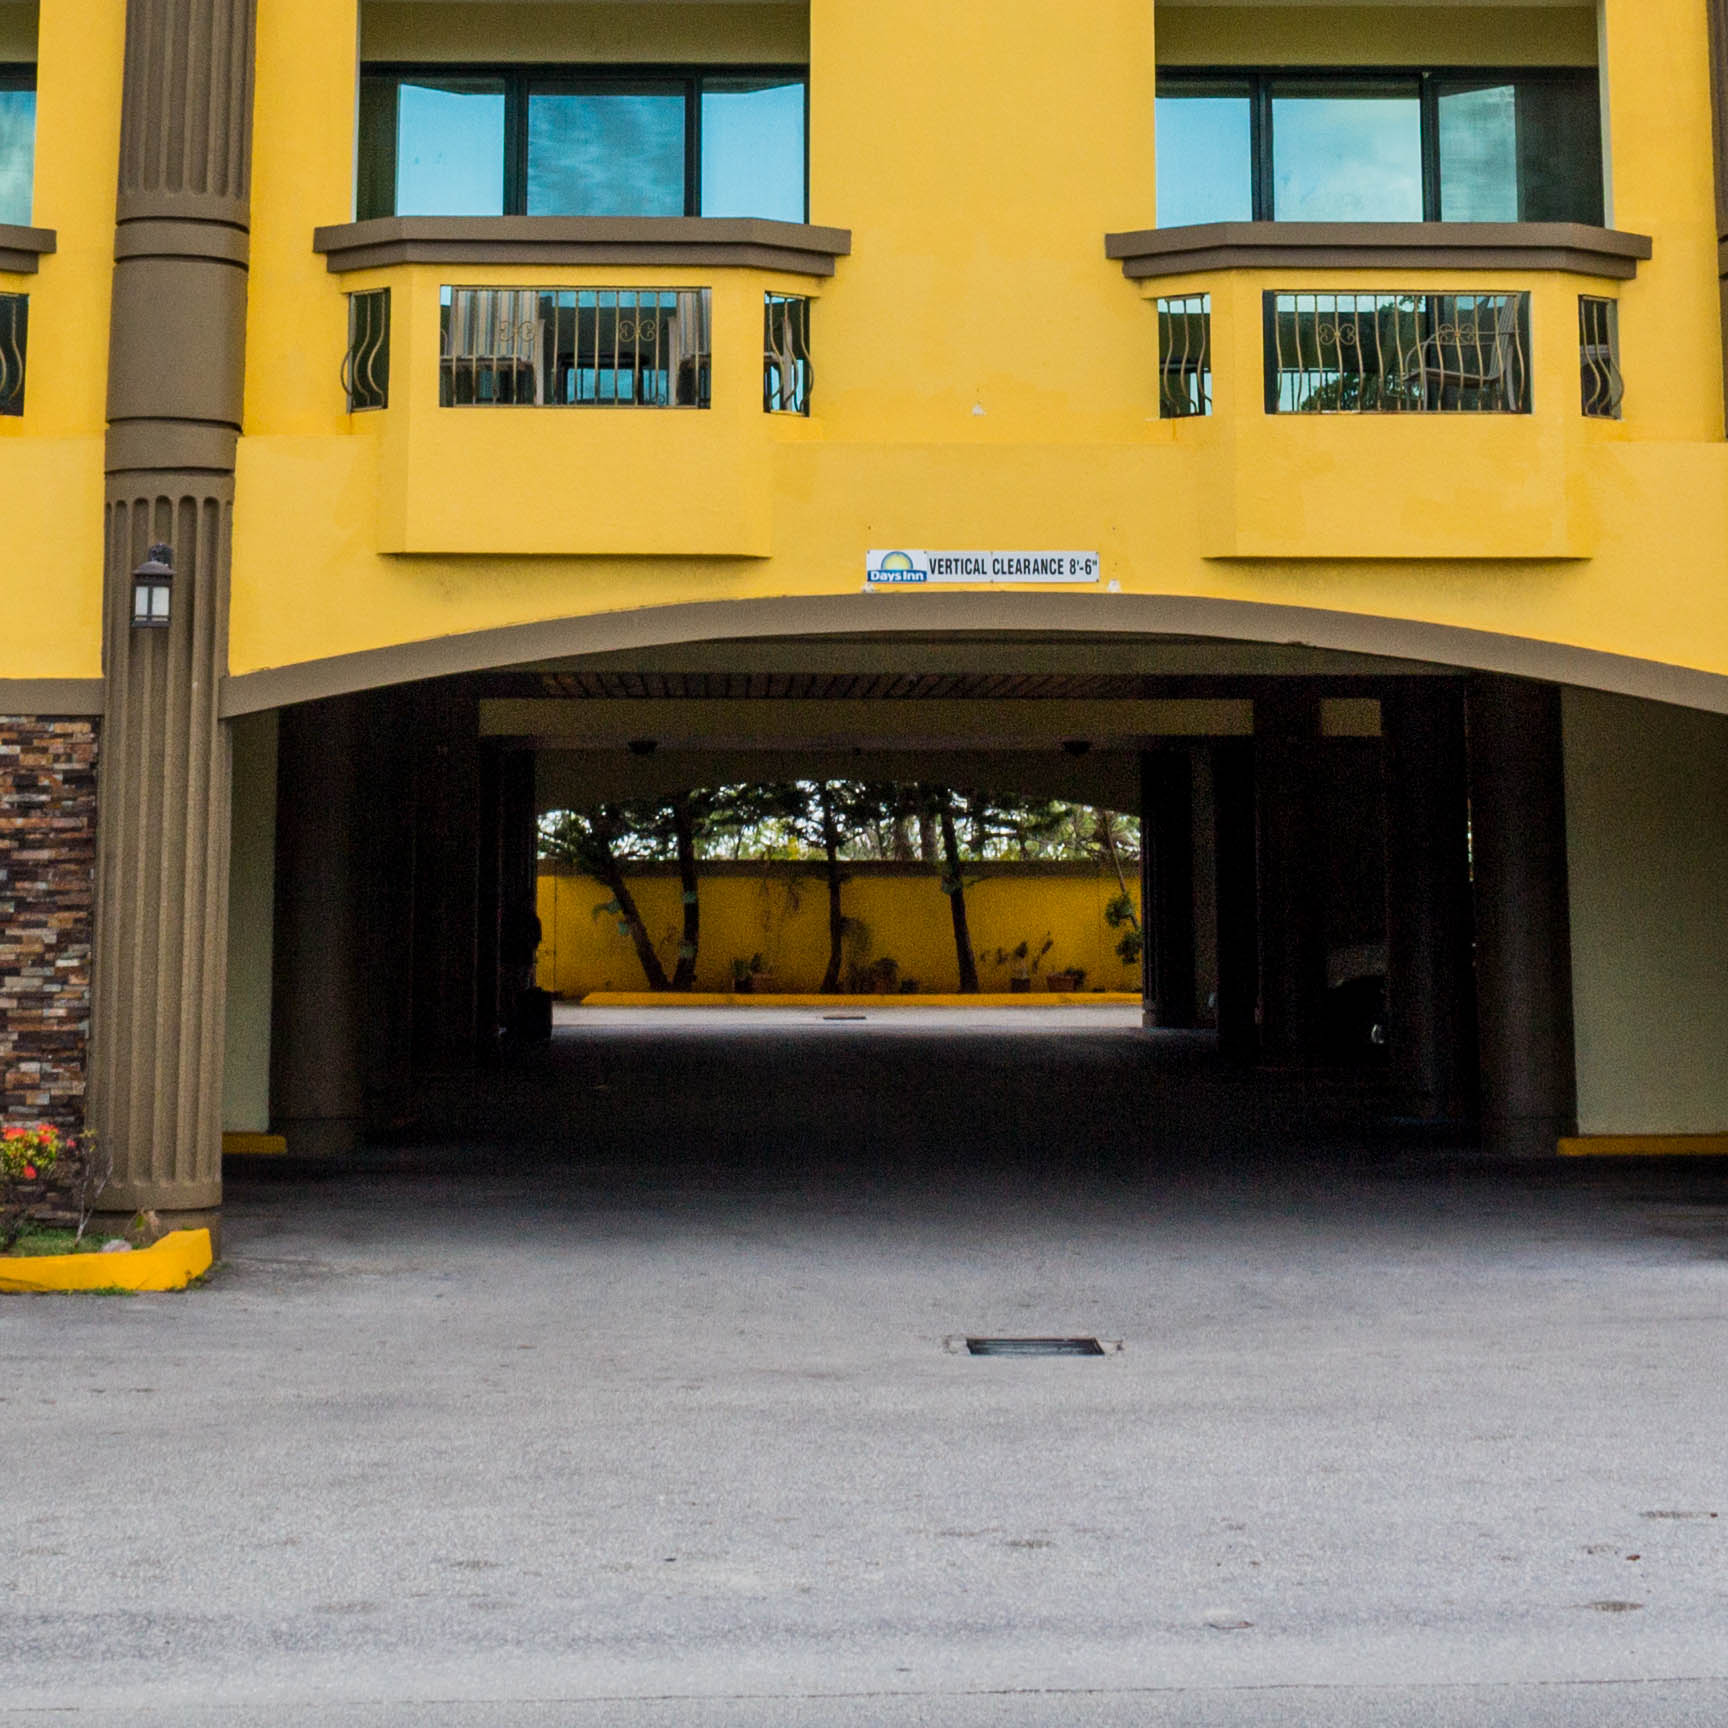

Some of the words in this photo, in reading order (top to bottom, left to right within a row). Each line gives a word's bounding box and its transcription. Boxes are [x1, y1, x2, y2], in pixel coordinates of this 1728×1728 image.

[928, 558, 988, 576] VERTICAL
[992, 558, 1064, 576] CLEARANCE
[870, 570, 902, 582] Days
[903, 570, 924, 581] Inn
